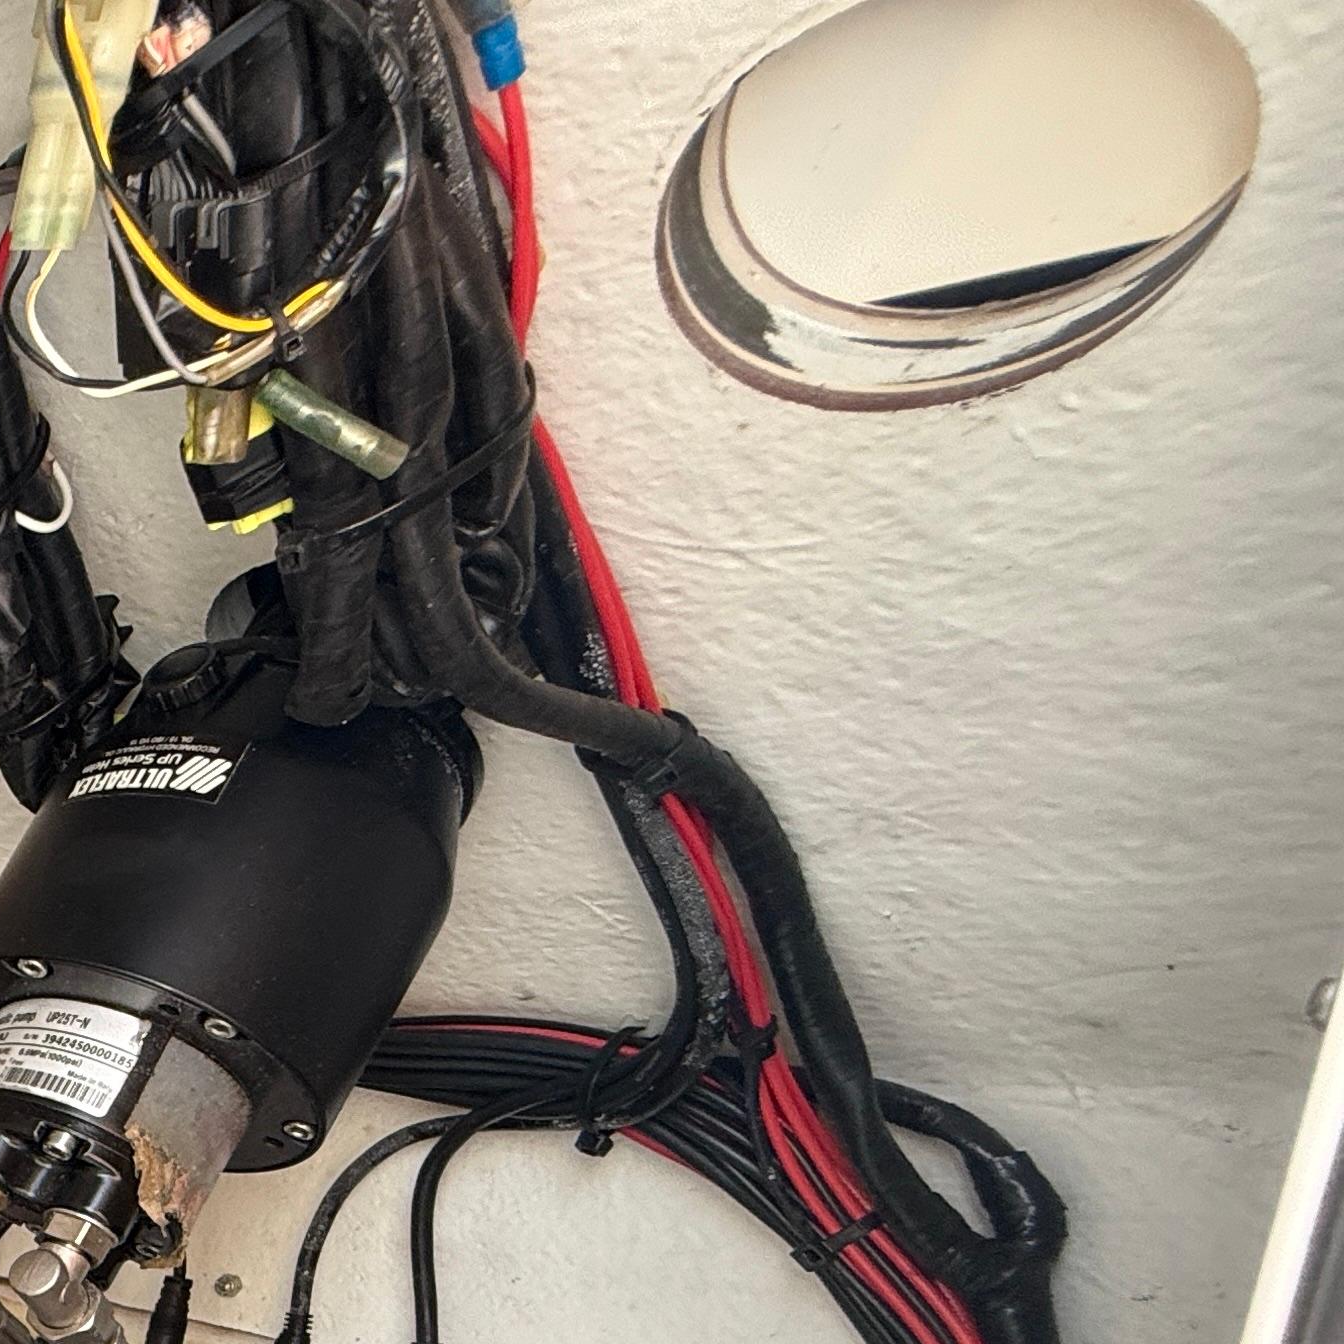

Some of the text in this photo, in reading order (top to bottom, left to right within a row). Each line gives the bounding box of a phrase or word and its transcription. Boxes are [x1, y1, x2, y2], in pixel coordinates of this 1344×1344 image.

[112, 753, 157, 767] Series
[157, 753, 183, 765] UP
[68, 768, 173, 799] ULTRAFLEX
[46, 1011, 90, 1029] UP25T-N
[42, 1033, 134, 1068] 3942450000185
